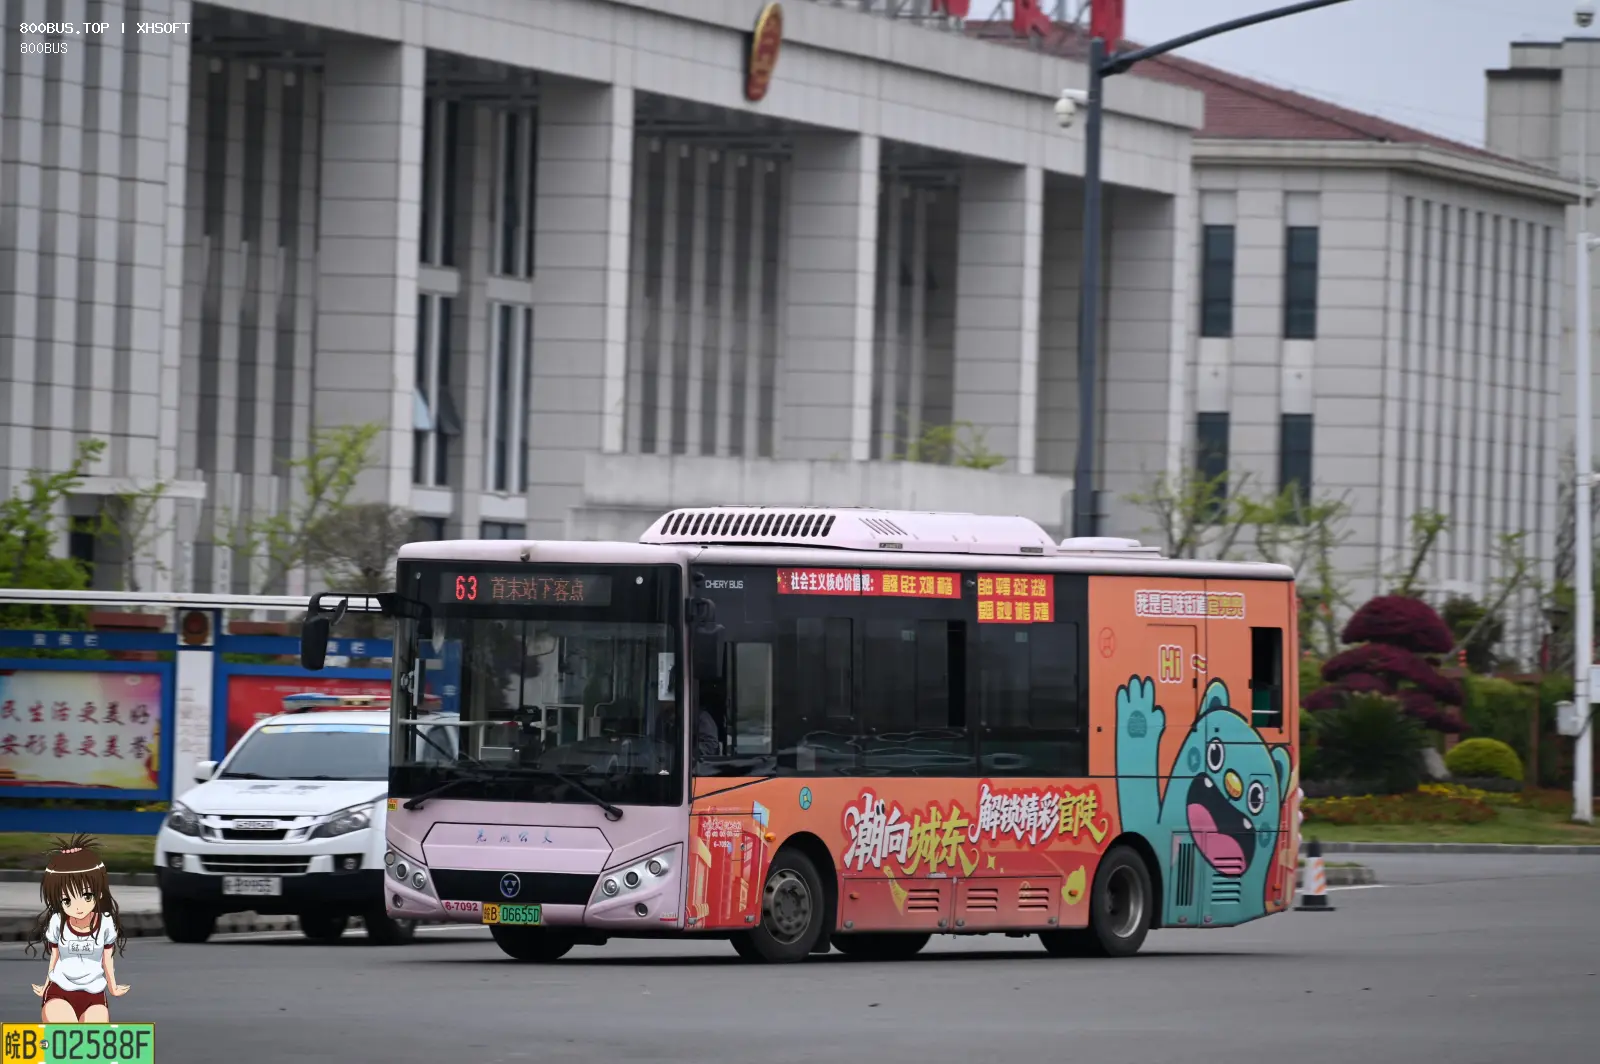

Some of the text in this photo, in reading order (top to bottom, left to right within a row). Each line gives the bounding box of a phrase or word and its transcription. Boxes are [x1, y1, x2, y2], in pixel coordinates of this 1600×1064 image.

[455, 575, 478, 600] 63
[491, 576, 585, 601] 首末站下客点
[705, 579, 744, 589] CHERY BUS
[1160, 646, 1182, 681] Hi
[843, 783, 1109, 877] 潮向城东 解锁精彩官陡
[444, 901, 479, 912] 6-7092
